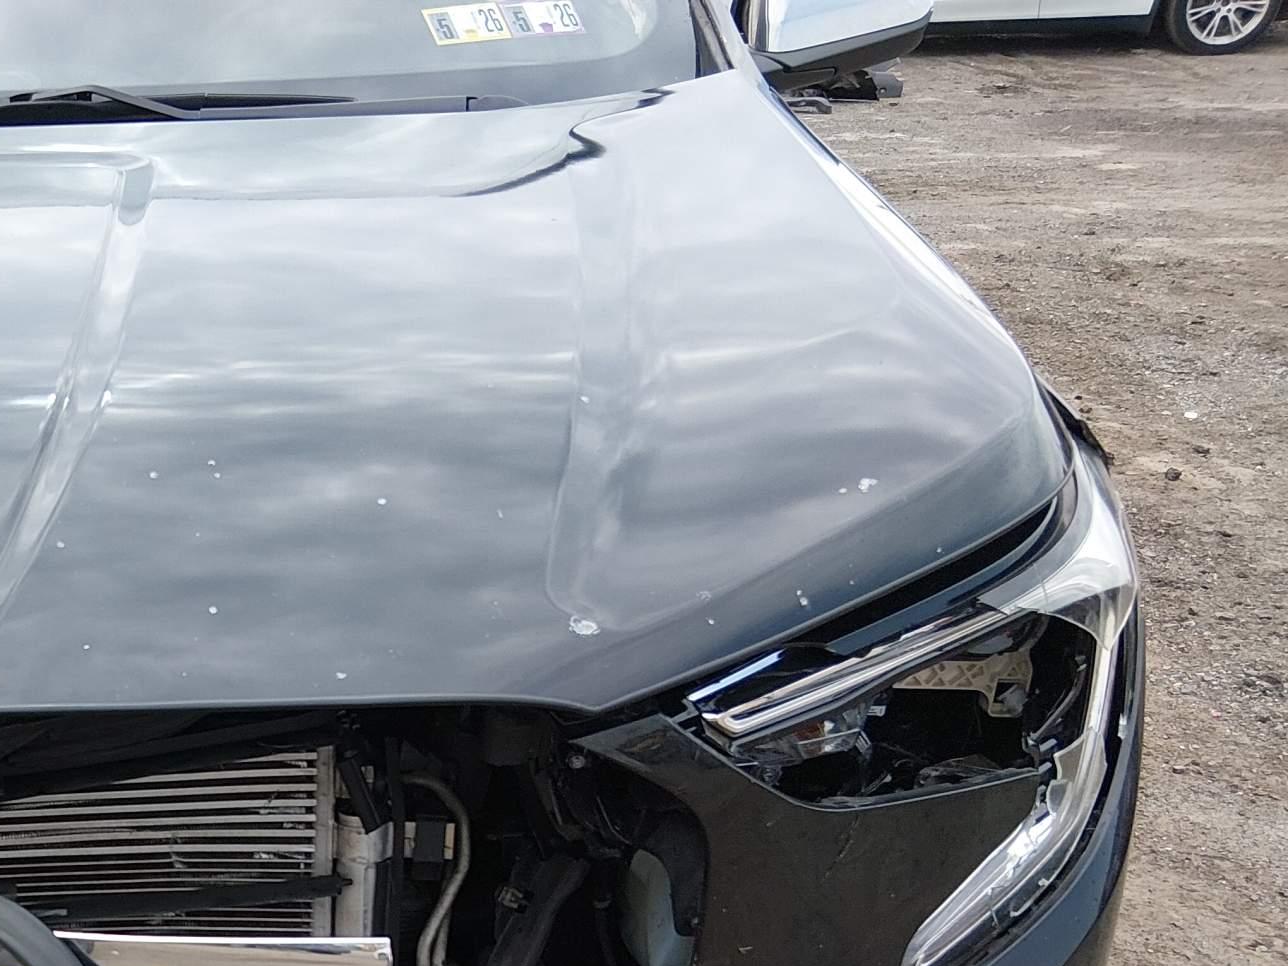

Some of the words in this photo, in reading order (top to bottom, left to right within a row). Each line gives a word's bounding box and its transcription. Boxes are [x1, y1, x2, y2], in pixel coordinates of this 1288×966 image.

[436, 18, 455, 39] 5
[477, 8, 504, 33] 26
[512, 11, 532, 33] 5
[553, 3, 579, 28] 26
